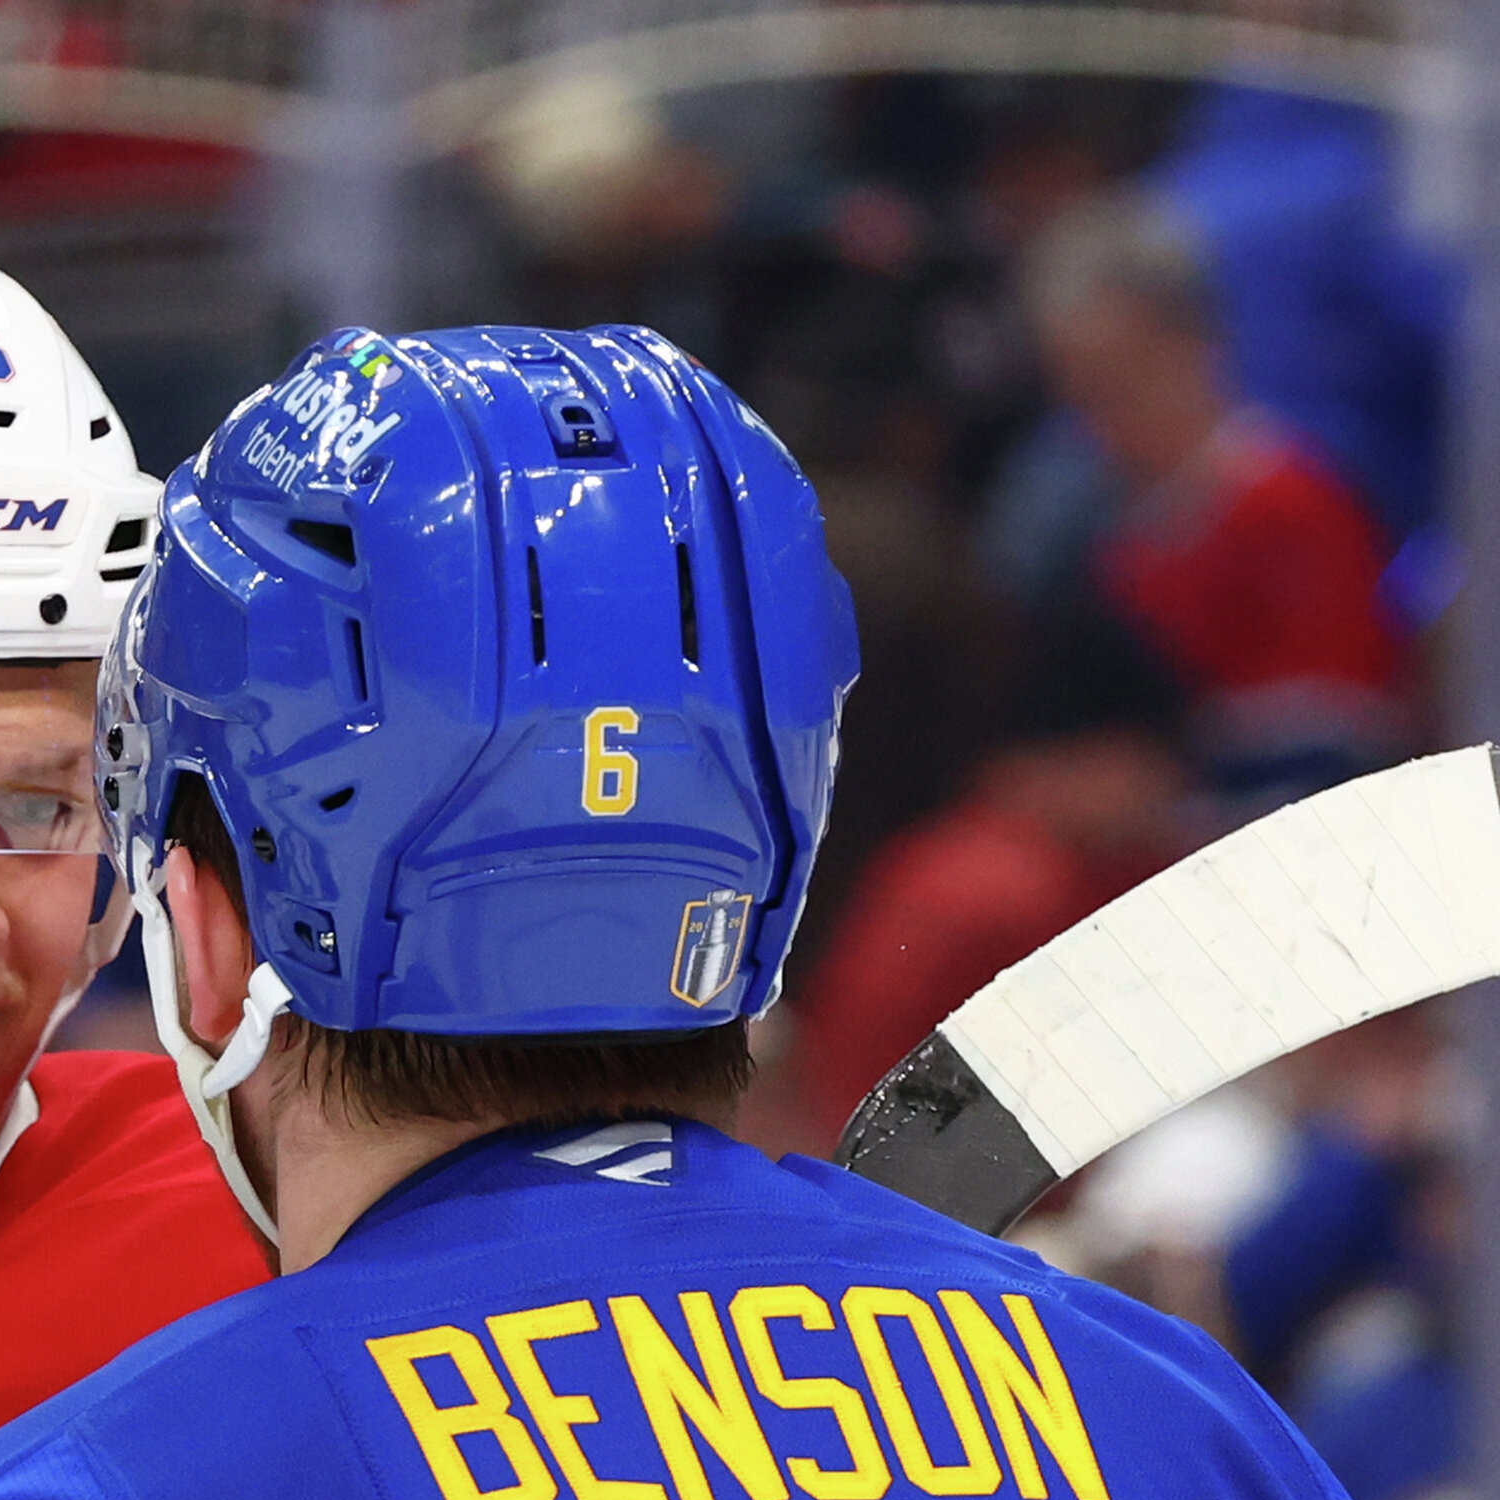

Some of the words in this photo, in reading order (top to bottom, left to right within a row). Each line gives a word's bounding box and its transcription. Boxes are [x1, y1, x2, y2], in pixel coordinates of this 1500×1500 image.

[241, 418, 307, 494] talent
[272, 353, 402, 466] rusted
[581, 706, 640, 816] 6
